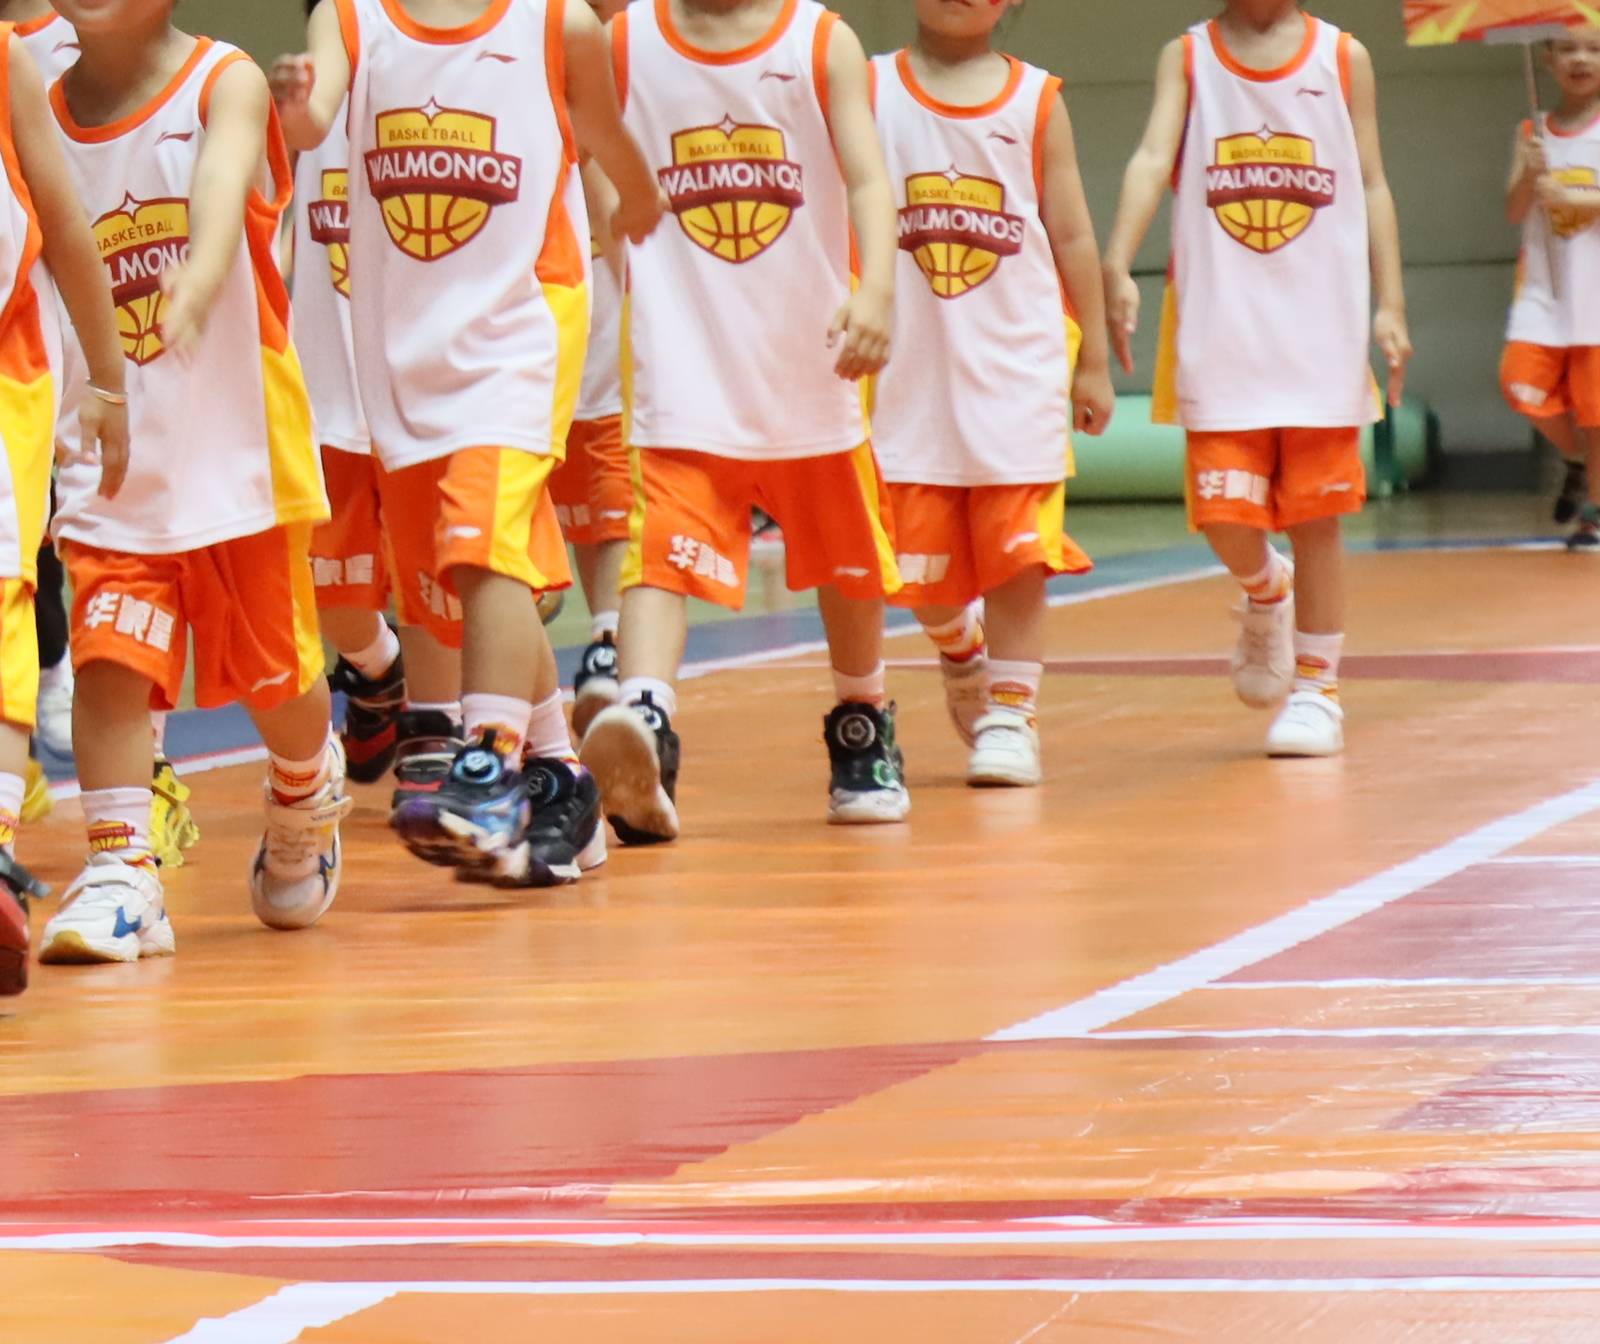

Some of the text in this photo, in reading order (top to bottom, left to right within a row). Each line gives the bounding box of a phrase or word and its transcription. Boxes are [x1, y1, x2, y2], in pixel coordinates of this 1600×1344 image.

[388, 129, 476, 144] BASKETBALL
[689, 142, 774, 157] BASKETBALL
[371, 151, 518, 189] WALMONOS
[97, 219, 174, 251] ASKETBALL
